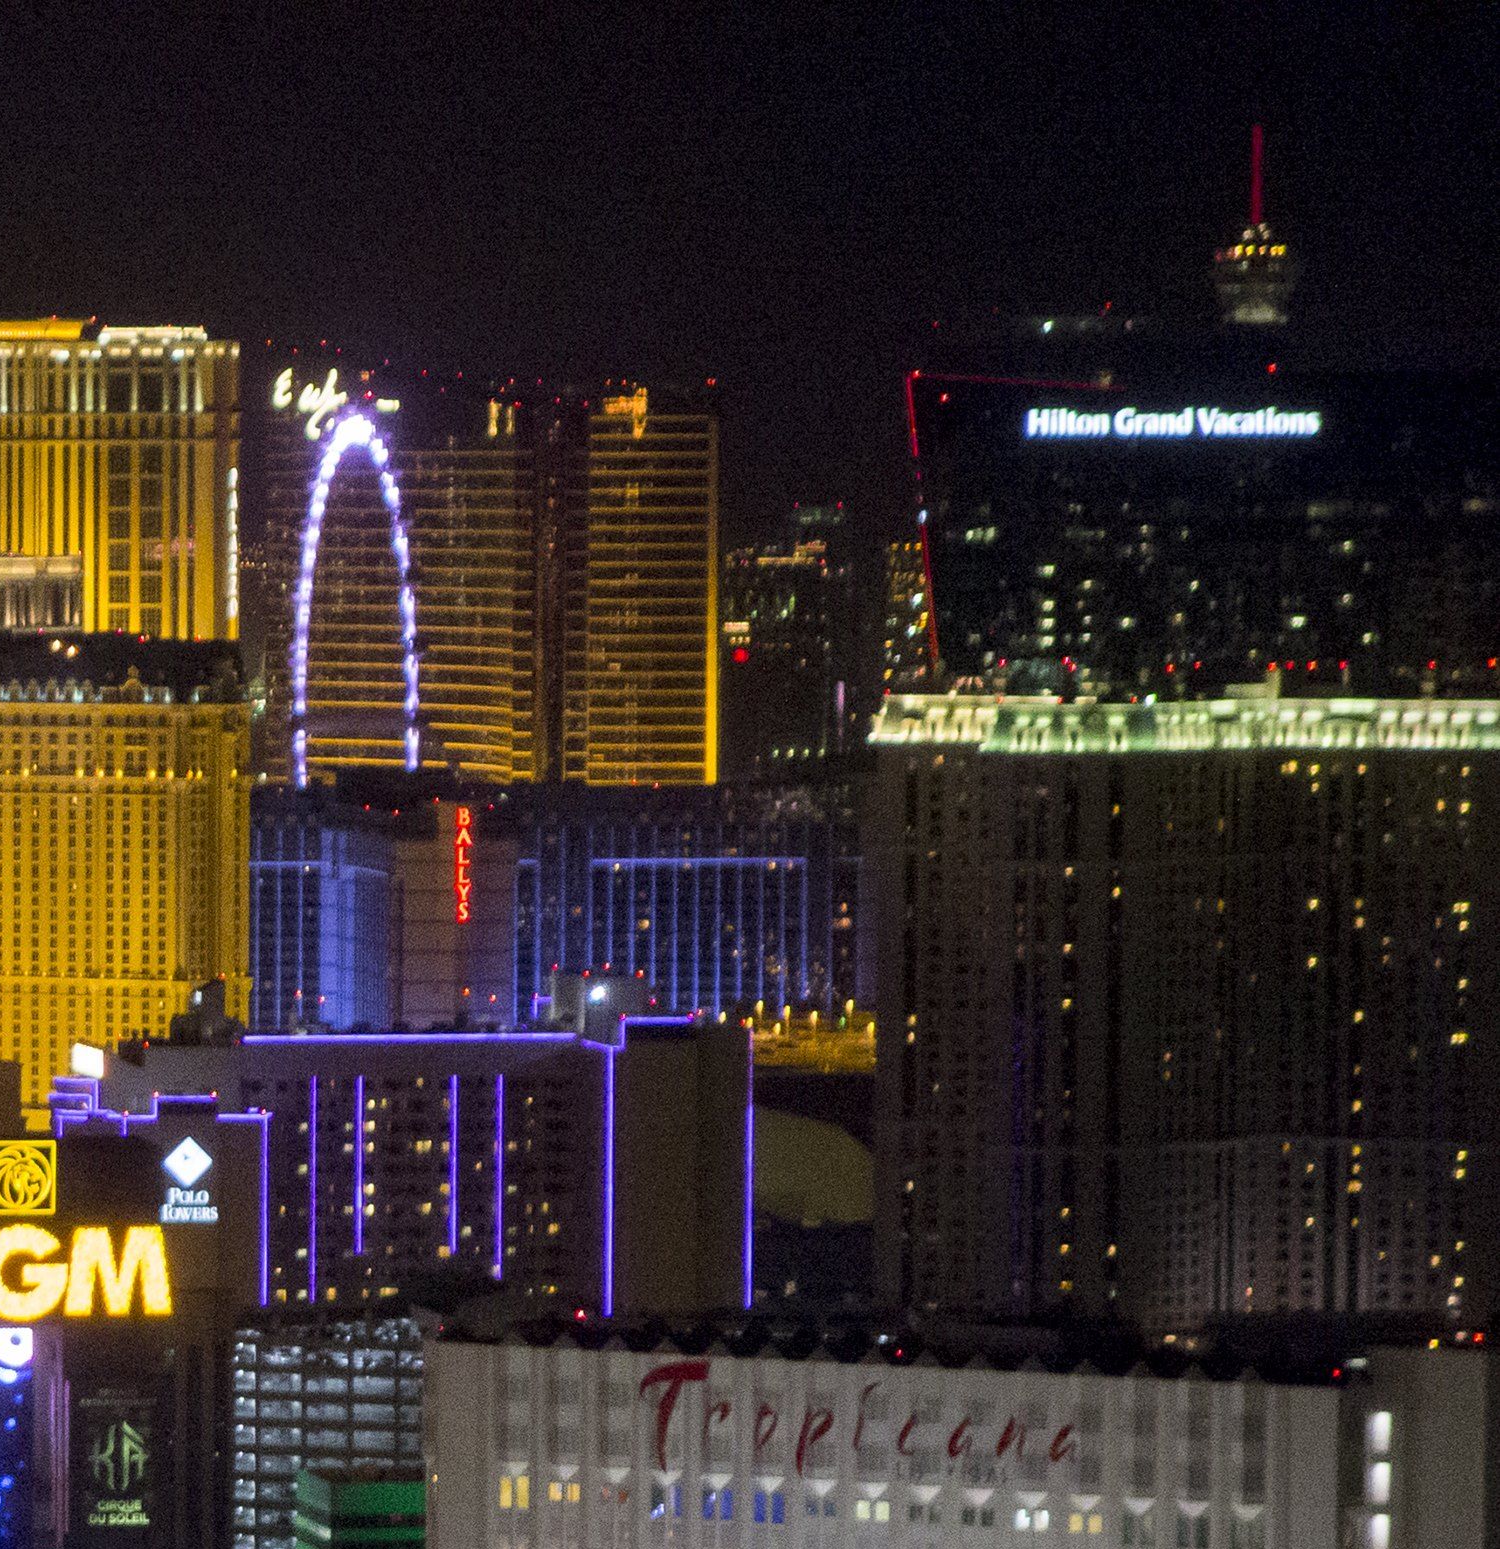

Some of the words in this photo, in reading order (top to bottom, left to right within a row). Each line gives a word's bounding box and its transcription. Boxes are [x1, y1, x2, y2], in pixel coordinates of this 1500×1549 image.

[1025, 407, 1110, 438] Hilton
[1113, 406, 1194, 438] Grand
[1196, 406, 1321, 438] Vacations
[166, 1187, 209, 1205] POLO
[159, 1205, 219, 1223] TOWERS
[640, 1362, 1080, 1475] Tropicana
[108, 1514, 149, 1525] SOLEIL
